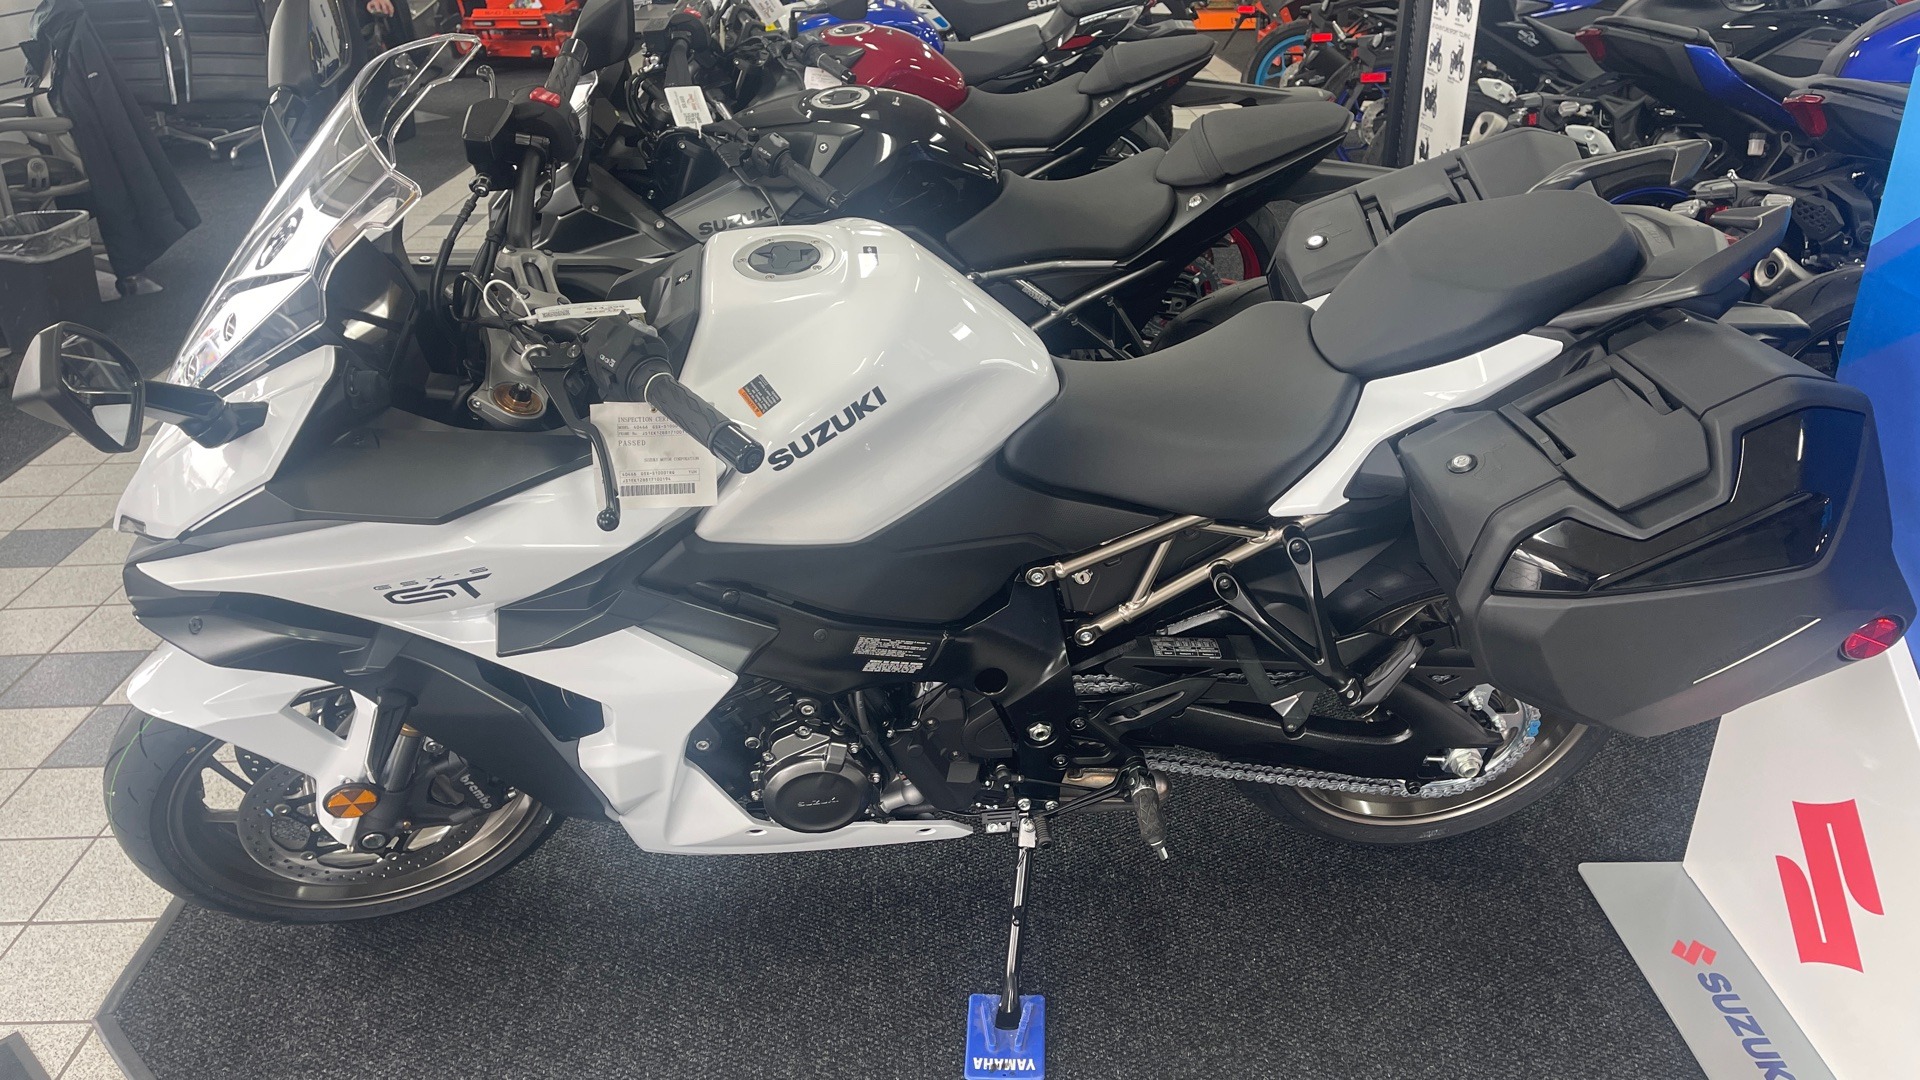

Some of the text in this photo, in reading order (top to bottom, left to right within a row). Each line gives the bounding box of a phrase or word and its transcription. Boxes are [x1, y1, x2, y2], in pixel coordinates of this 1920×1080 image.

[1027, 0, 1060, 10] SUZ
[768, 385, 888, 472] SUZUKI
[383, 573, 492, 604] GT
[460, 774, 492, 809] brembo
[973, 1057, 1036, 1071] YAMAHA
